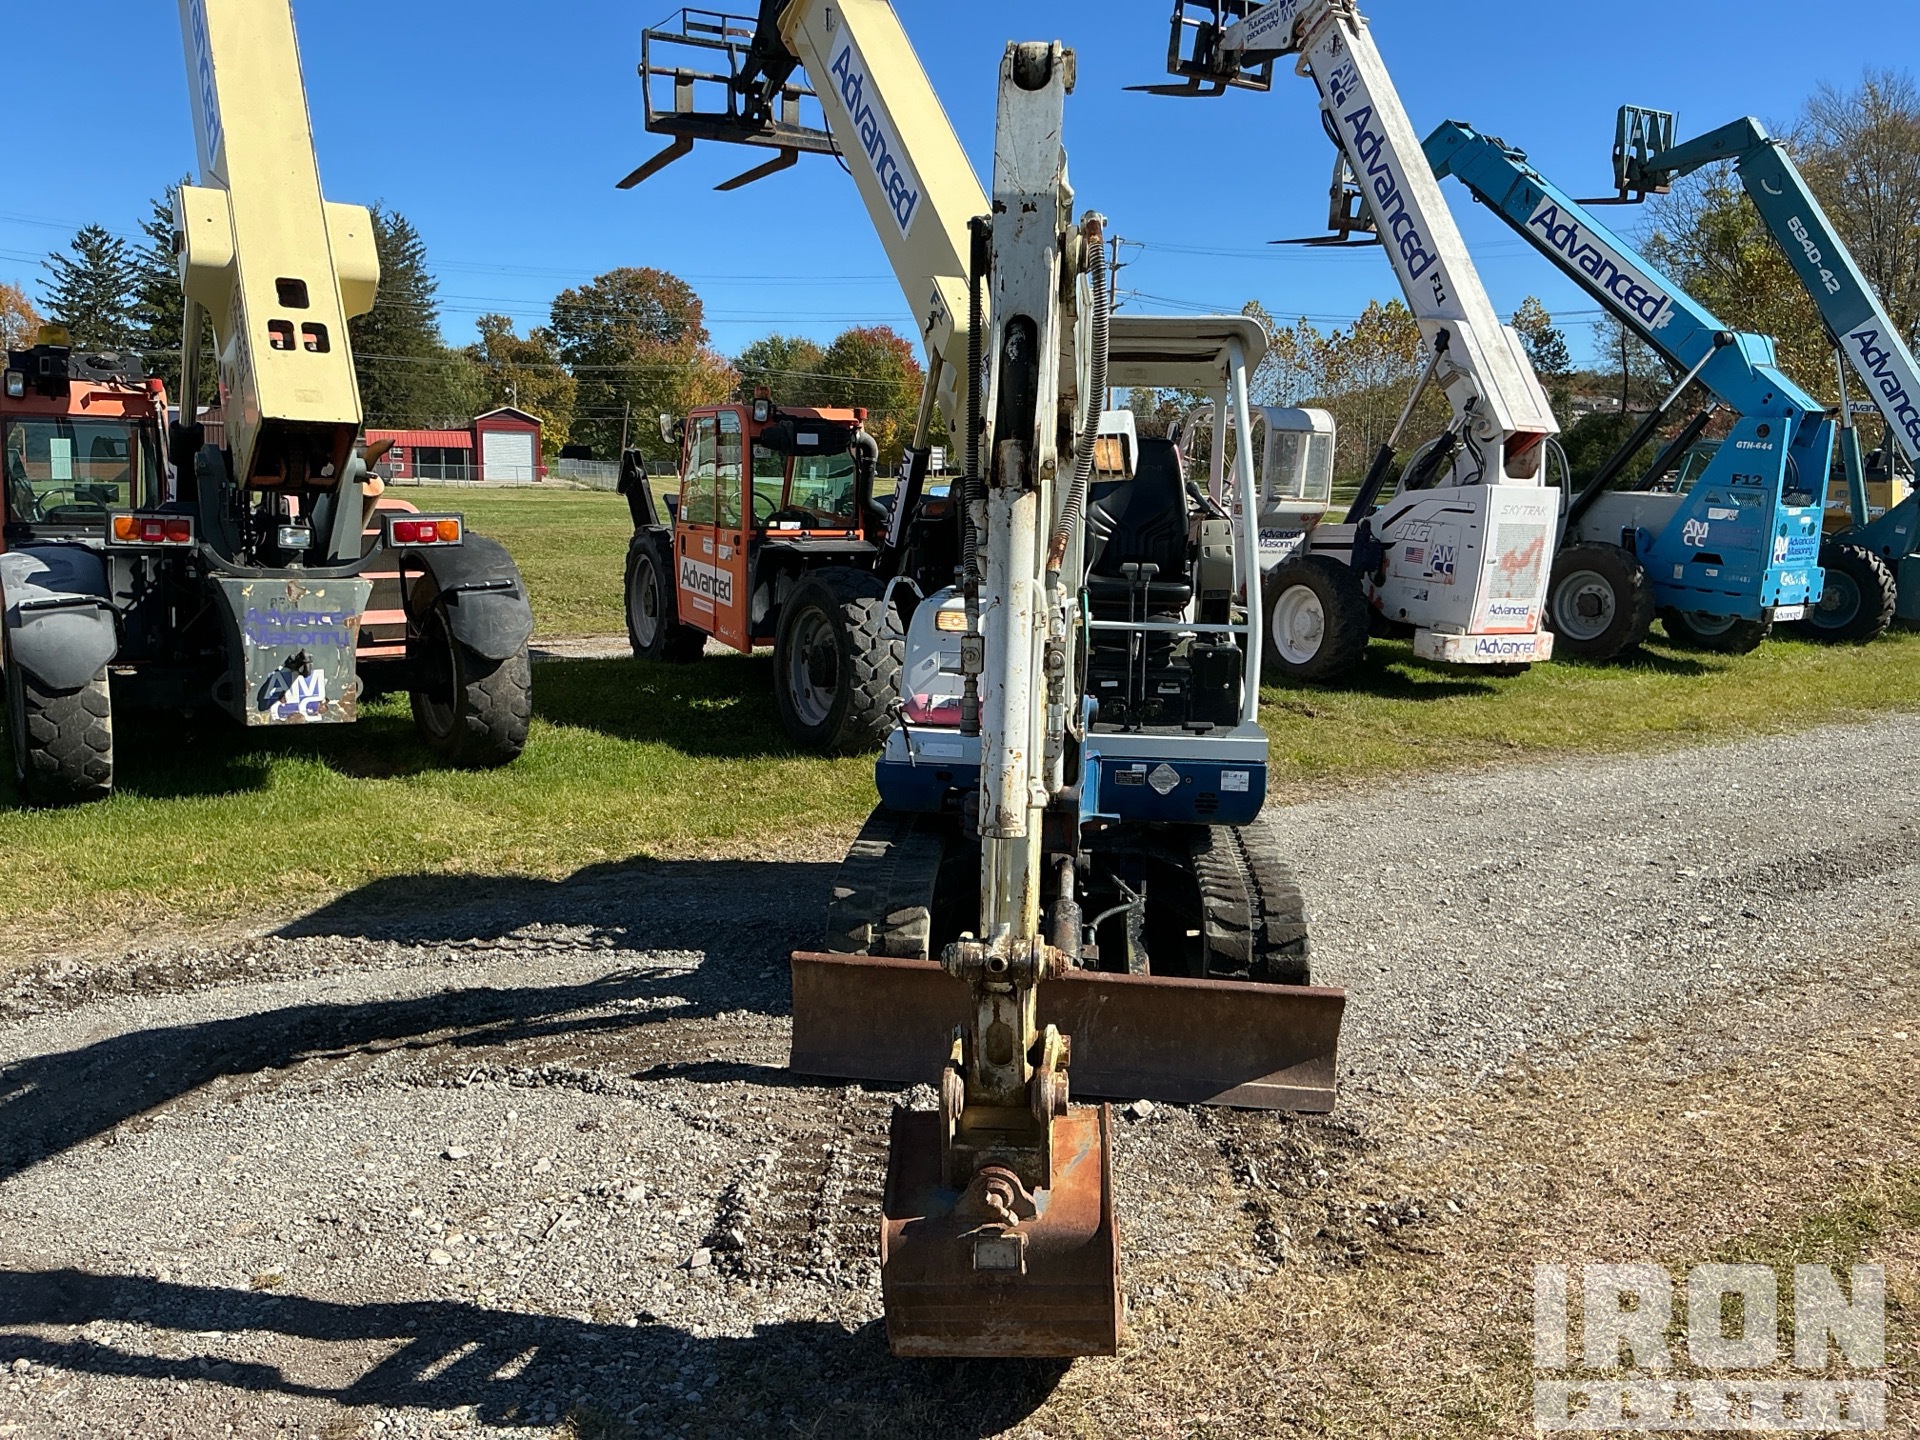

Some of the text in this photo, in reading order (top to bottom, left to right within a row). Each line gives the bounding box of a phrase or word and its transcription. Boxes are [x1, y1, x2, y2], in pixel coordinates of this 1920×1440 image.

[831, 44, 918, 230] Advanced
[1344, 105, 1437, 281] Advanced
[1529, 204, 1669, 324] Advanced
[1787, 215, 1841, 295] 534D-42
[1429, 271, 1447, 307] F11
[1736, 441, 1773, 451] GTH-644
[1731, 473, 1763, 486] F12
[1259, 529, 1302, 539] Advanced
[1394, 522, 1432, 543] JLG
[1788, 536, 1817, 547] Advanced
[1488, 604, 1530, 616] Advanced
[244, 627, 350, 648] Masonry
[1476, 638, 1538, 657] Advanced
